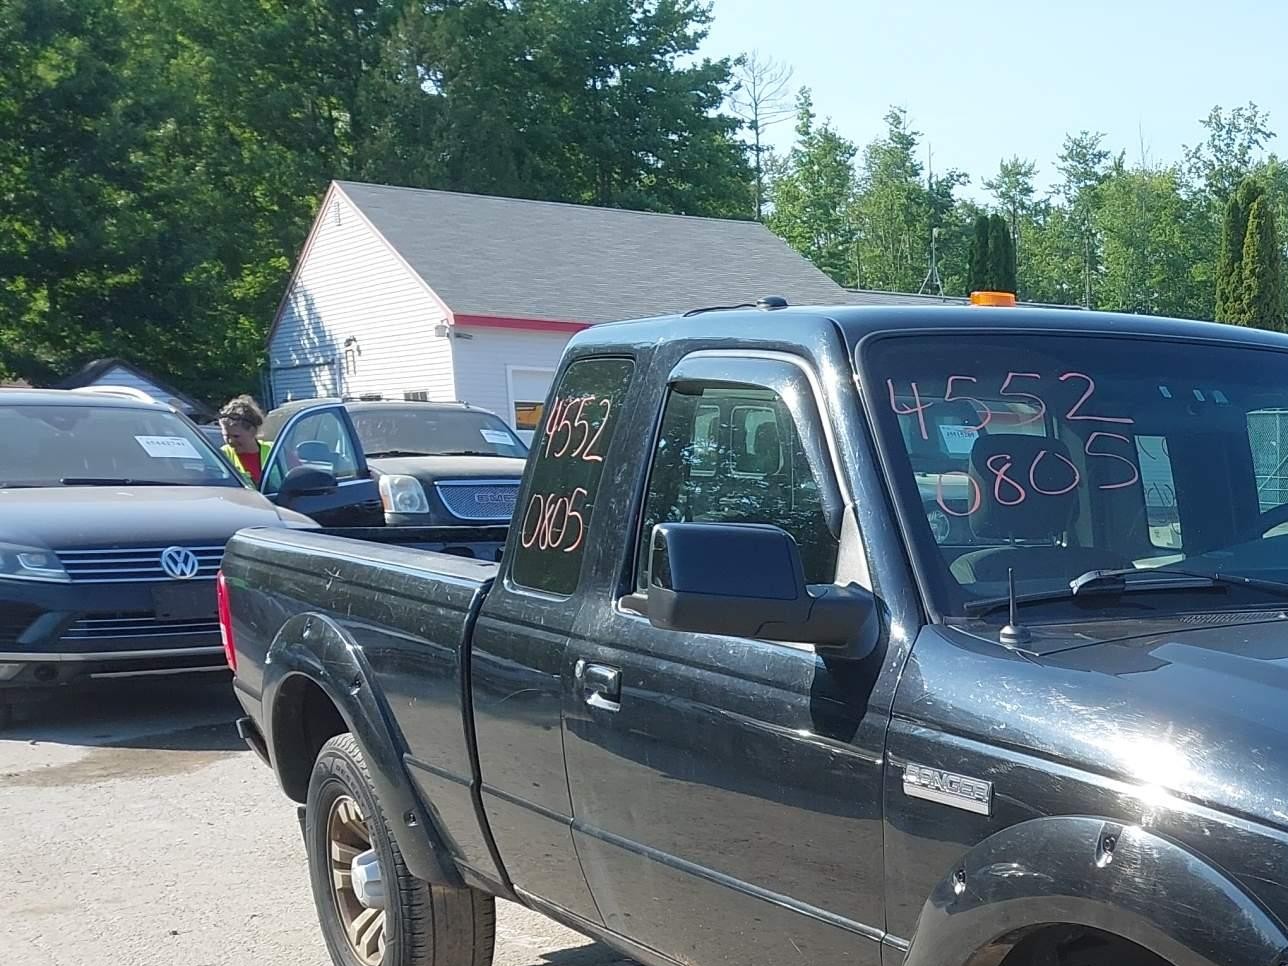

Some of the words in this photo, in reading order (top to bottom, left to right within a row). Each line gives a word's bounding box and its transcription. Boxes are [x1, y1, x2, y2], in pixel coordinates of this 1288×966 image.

[546, 396, 613, 461] 4552
[887, 371, 1135, 440] 4552
[936, 432, 1139, 516] 0805
[522, 488, 588, 551] 0805
[162, 546, 198, 579] VW
[905, 763, 990, 803] RANGER
